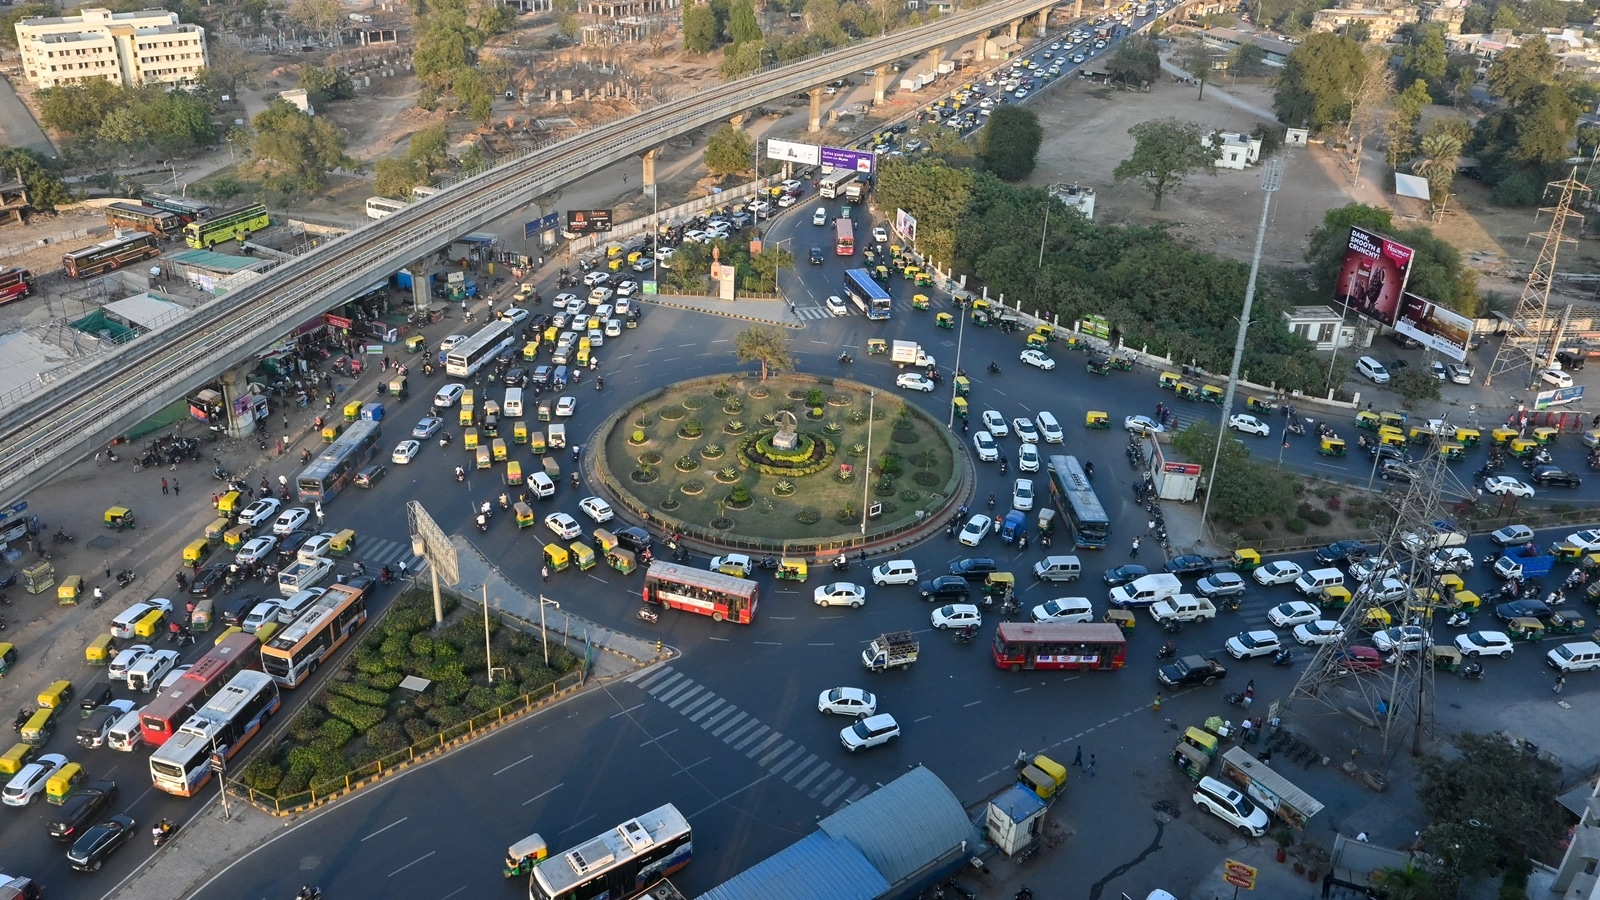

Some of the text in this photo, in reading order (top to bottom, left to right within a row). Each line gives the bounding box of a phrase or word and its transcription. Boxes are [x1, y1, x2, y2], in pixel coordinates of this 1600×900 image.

[1350, 236, 1376, 251] SMOOTH
[1351, 230, 1370, 242] DARK,
[1348, 243, 1380, 260] CRUNCHY!
